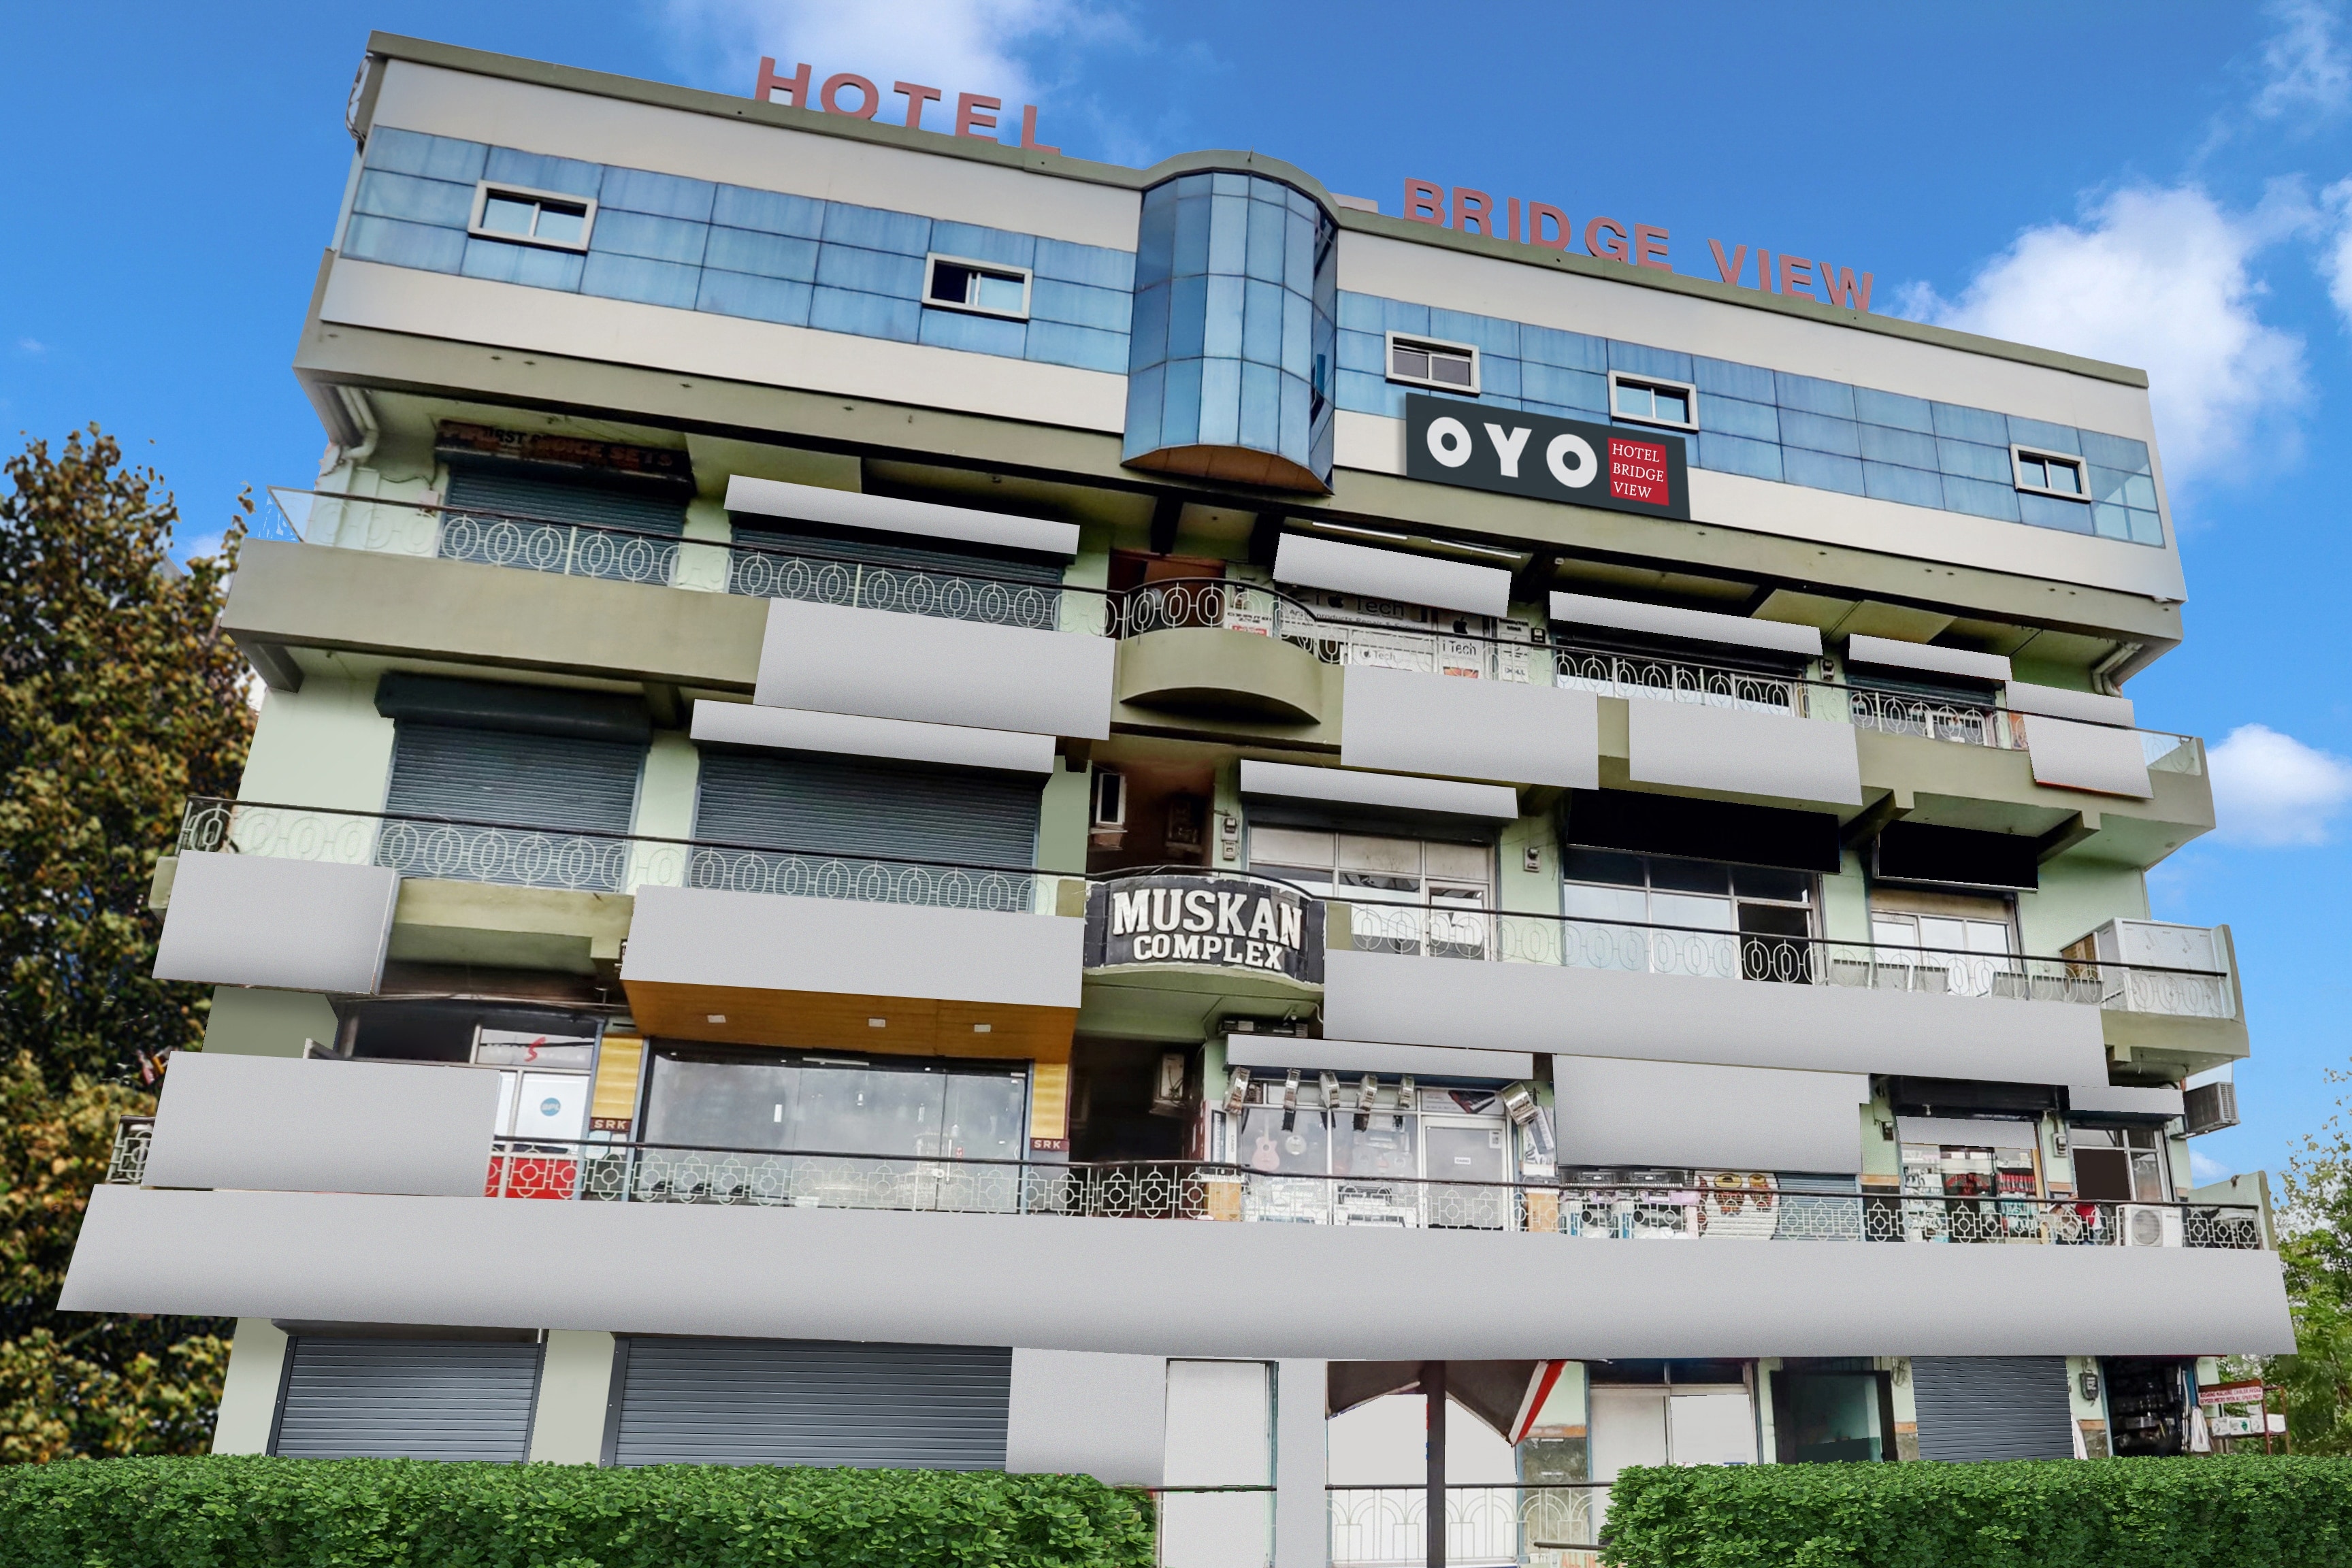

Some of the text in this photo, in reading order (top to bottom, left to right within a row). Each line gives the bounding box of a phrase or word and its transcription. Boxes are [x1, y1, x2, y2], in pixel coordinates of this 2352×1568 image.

[754, 56, 1062, 155] HOTEL
[1403, 177, 1874, 312] BRIDGE VIEW
[1426, 416, 1599, 489] OYO
[1612, 443, 1660, 463] HOTEL
[1612, 463, 1664, 483] BRIDGE
[1613, 481, 1652, 498] VIEW
[1356, 597, 1405, 617] Tech
[1450, 640, 1477, 656] Tech
[1112, 889, 1303, 951] MUSKAN
[1132, 932, 1285, 971] COMPLEX
[593, 1120, 627, 1130] SRK
[1034, 1139, 1061, 1149] SRK
